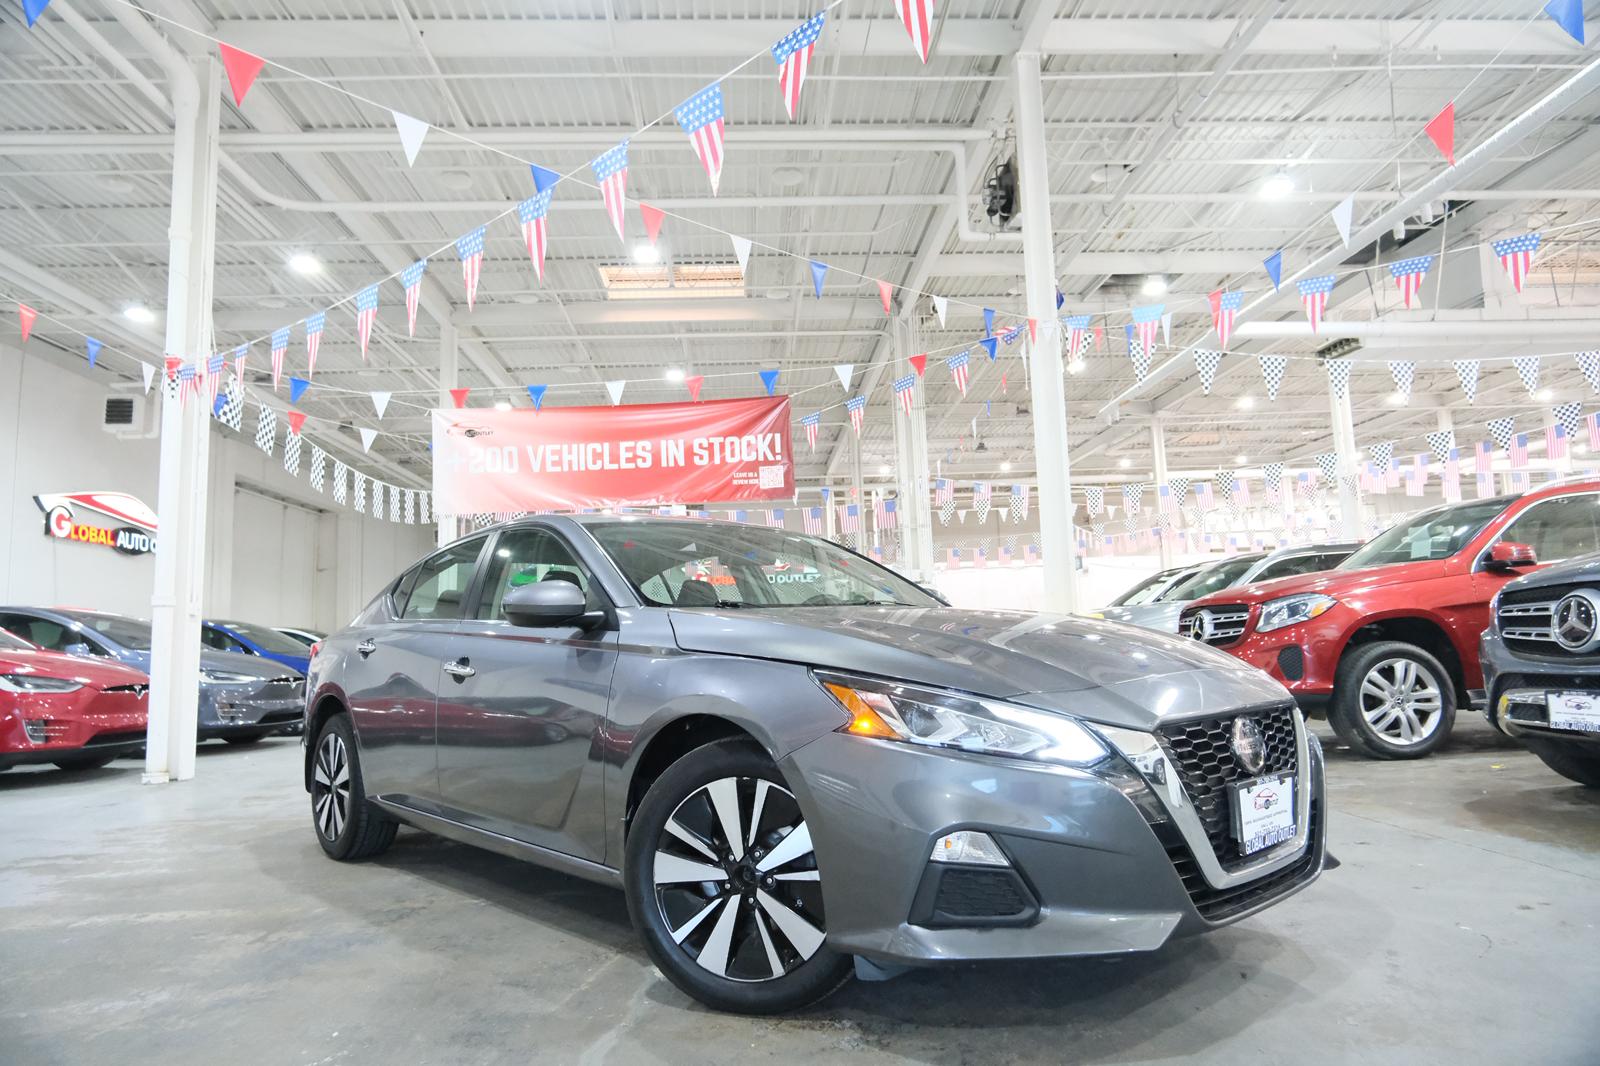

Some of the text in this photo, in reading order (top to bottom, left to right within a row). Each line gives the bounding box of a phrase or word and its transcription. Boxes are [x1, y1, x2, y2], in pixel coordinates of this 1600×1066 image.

[526, 440, 653, 473] VEHICLES
[660, 439, 685, 467] IN
[693, 433, 782, 466] STOCK!
[50, 505, 115, 546] GLOBAL
[116, 530, 149, 552] AUTO
[777, 573, 821, 584] OUTLET
[1246, 835, 1265, 855] GLOBAL
[1265, 831, 1278, 848] AUTO
[1279, 824, 1297, 842] OUTLET
